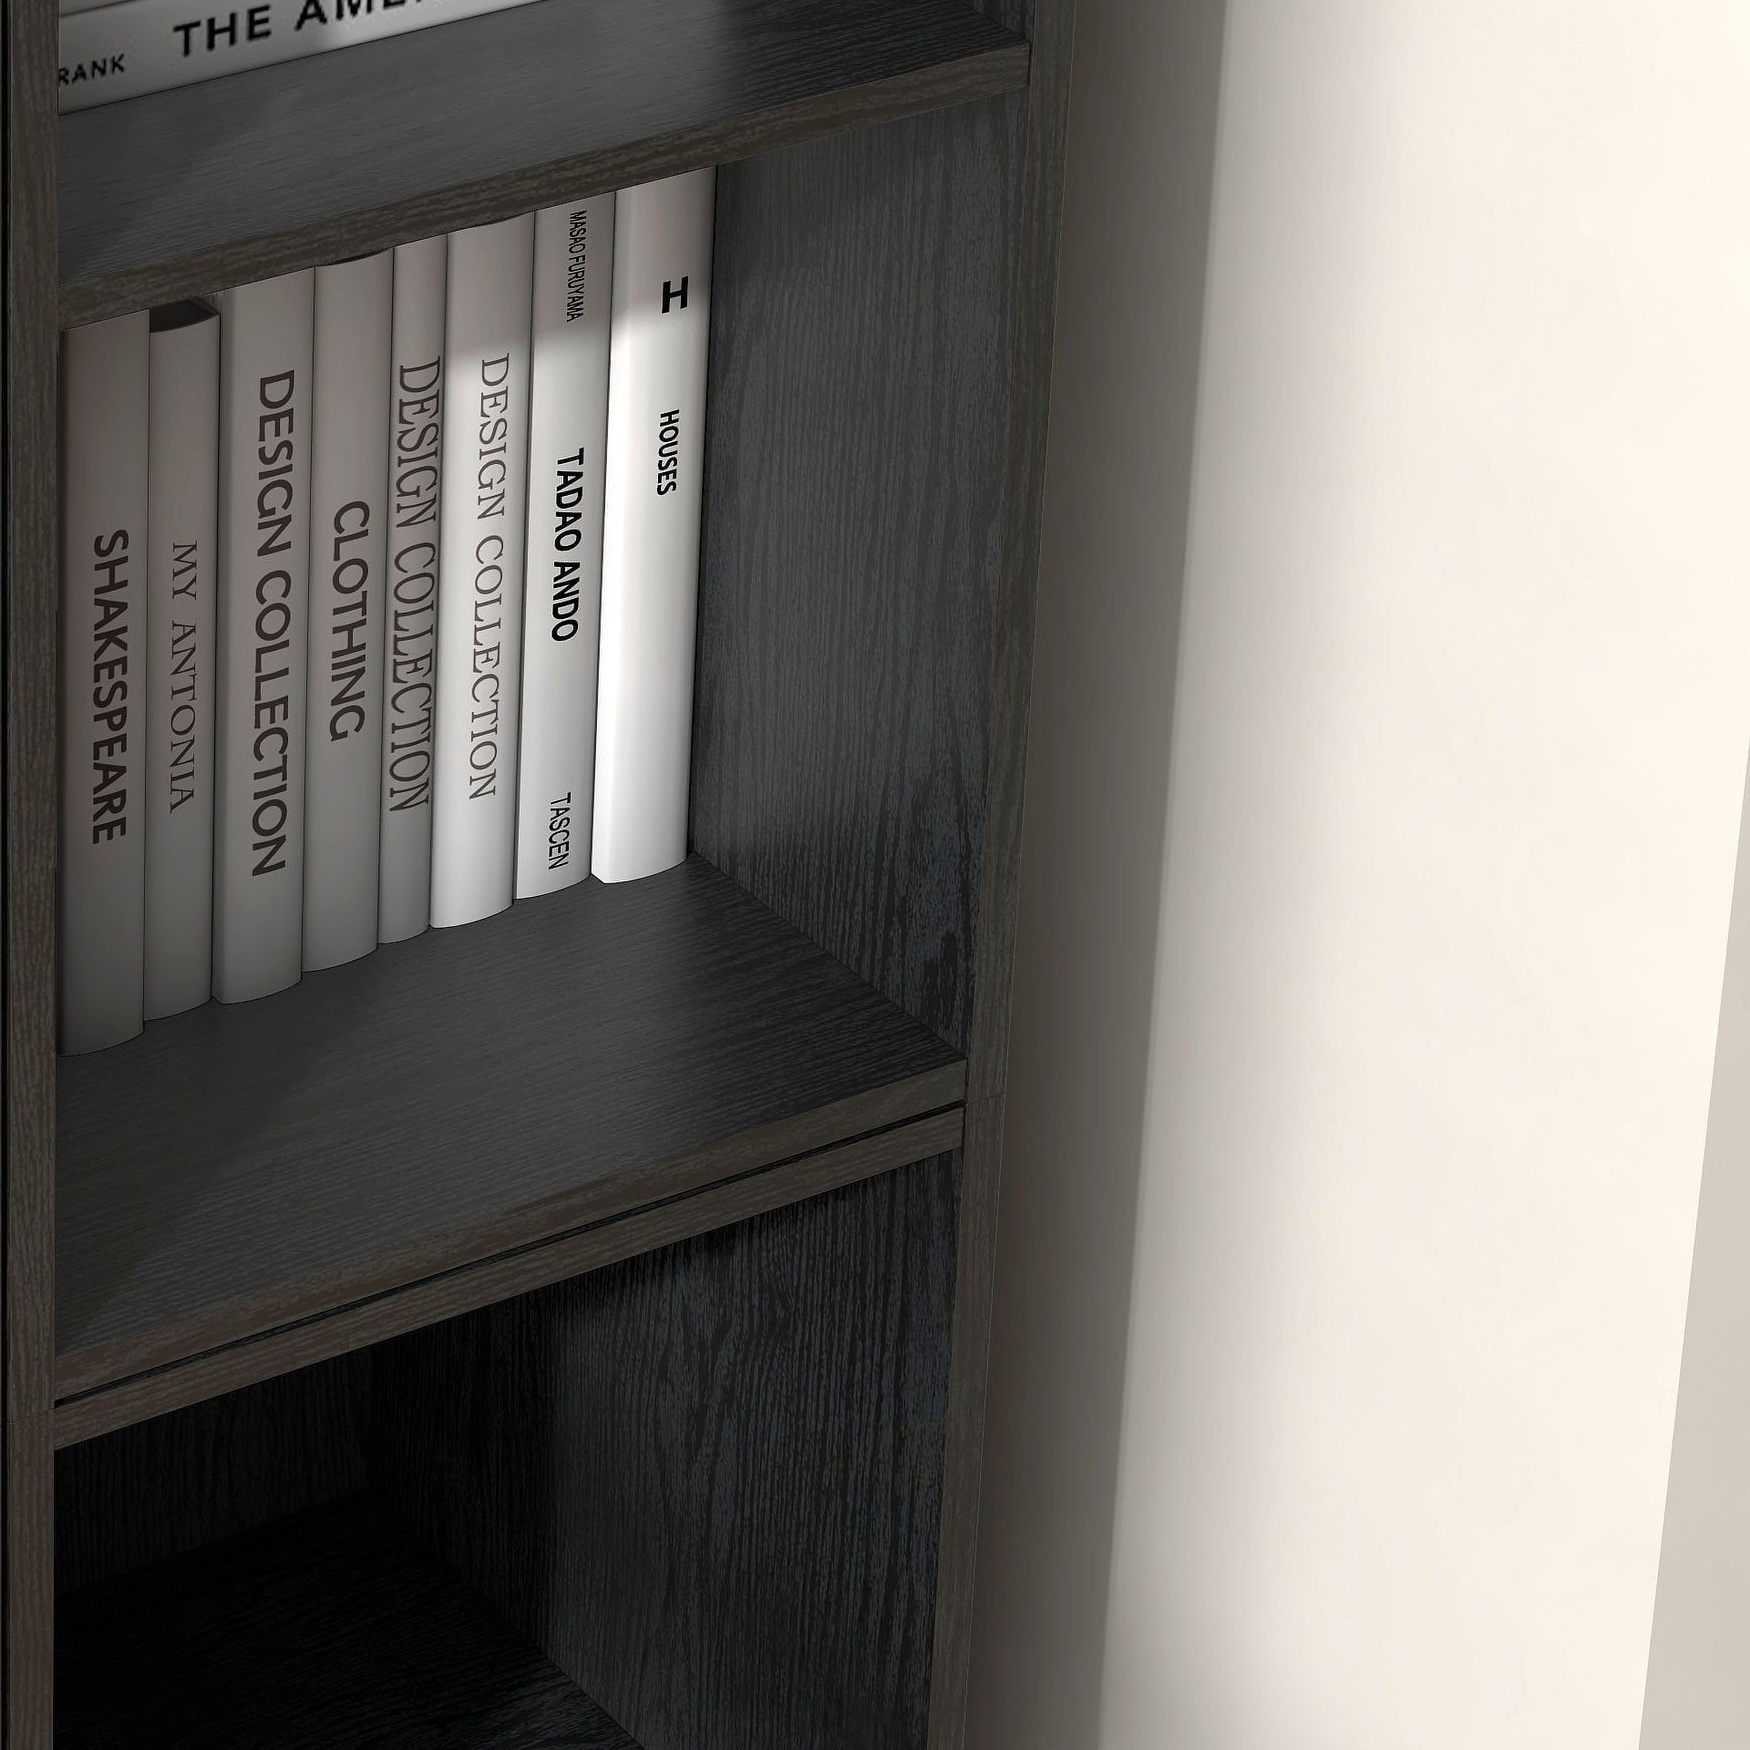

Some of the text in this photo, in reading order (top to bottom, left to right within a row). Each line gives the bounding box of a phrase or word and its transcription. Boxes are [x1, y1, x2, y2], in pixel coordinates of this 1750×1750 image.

[172, 4, 272, 58] THE
[567, 210, 587, 323] MASAO FURUYAMA
[662, 276, 688, 314] H
[552, 447, 584, 641] TADAO ANDO
[657, 409, 679, 495] HOUSES
[170, 540, 197, 814] MY ANTONIA
[252, 370, 294, 876] DESIGN COLLECTION
[330, 501, 370, 742] CLOTHING
[389, 356, 441, 814] DESIGN COLLECTION
[469, 353, 511, 802] DESIGN COLLECTION
[93, 530, 129, 844] SHAKESPEARE
[549, 792, 571, 870] TASCEN
